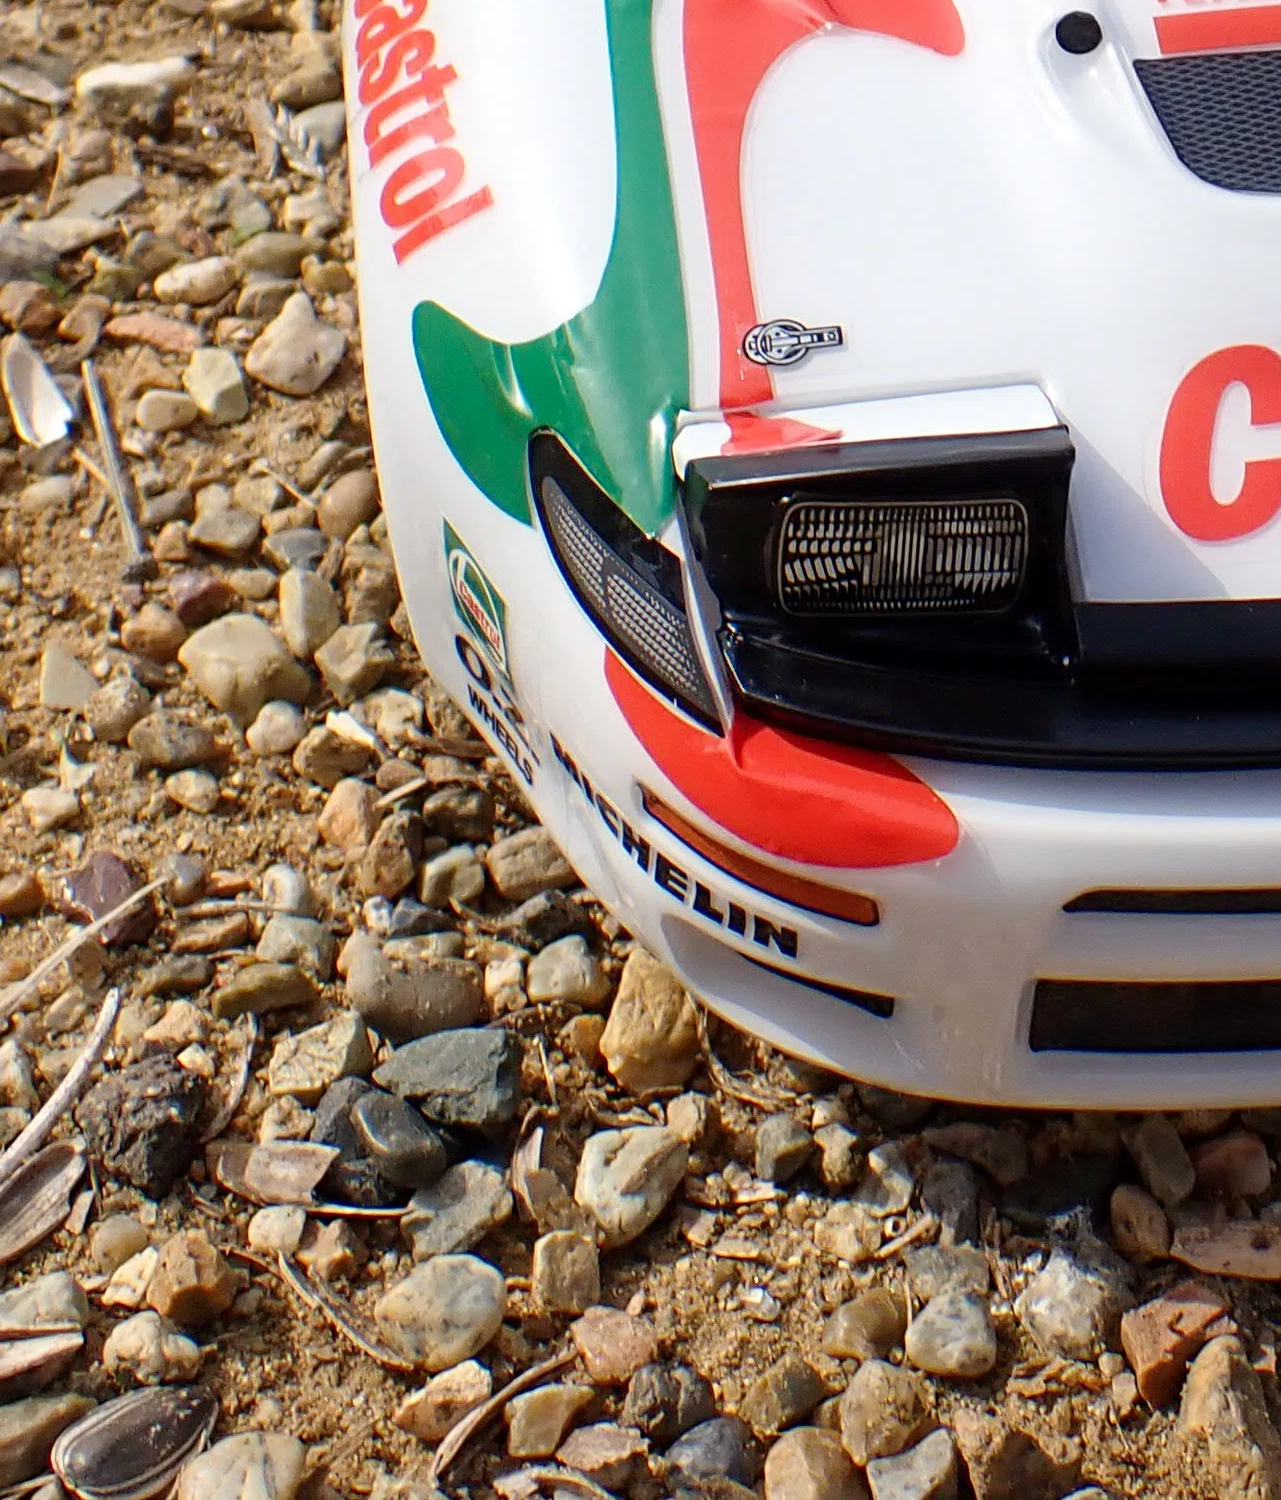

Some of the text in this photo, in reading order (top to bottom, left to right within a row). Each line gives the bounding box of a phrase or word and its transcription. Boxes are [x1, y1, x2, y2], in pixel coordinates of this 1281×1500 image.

[459, 580, 500, 651] Castrol
[467, 683, 534, 787] WHEELS
[548, 730, 799, 960] MICHELIN
